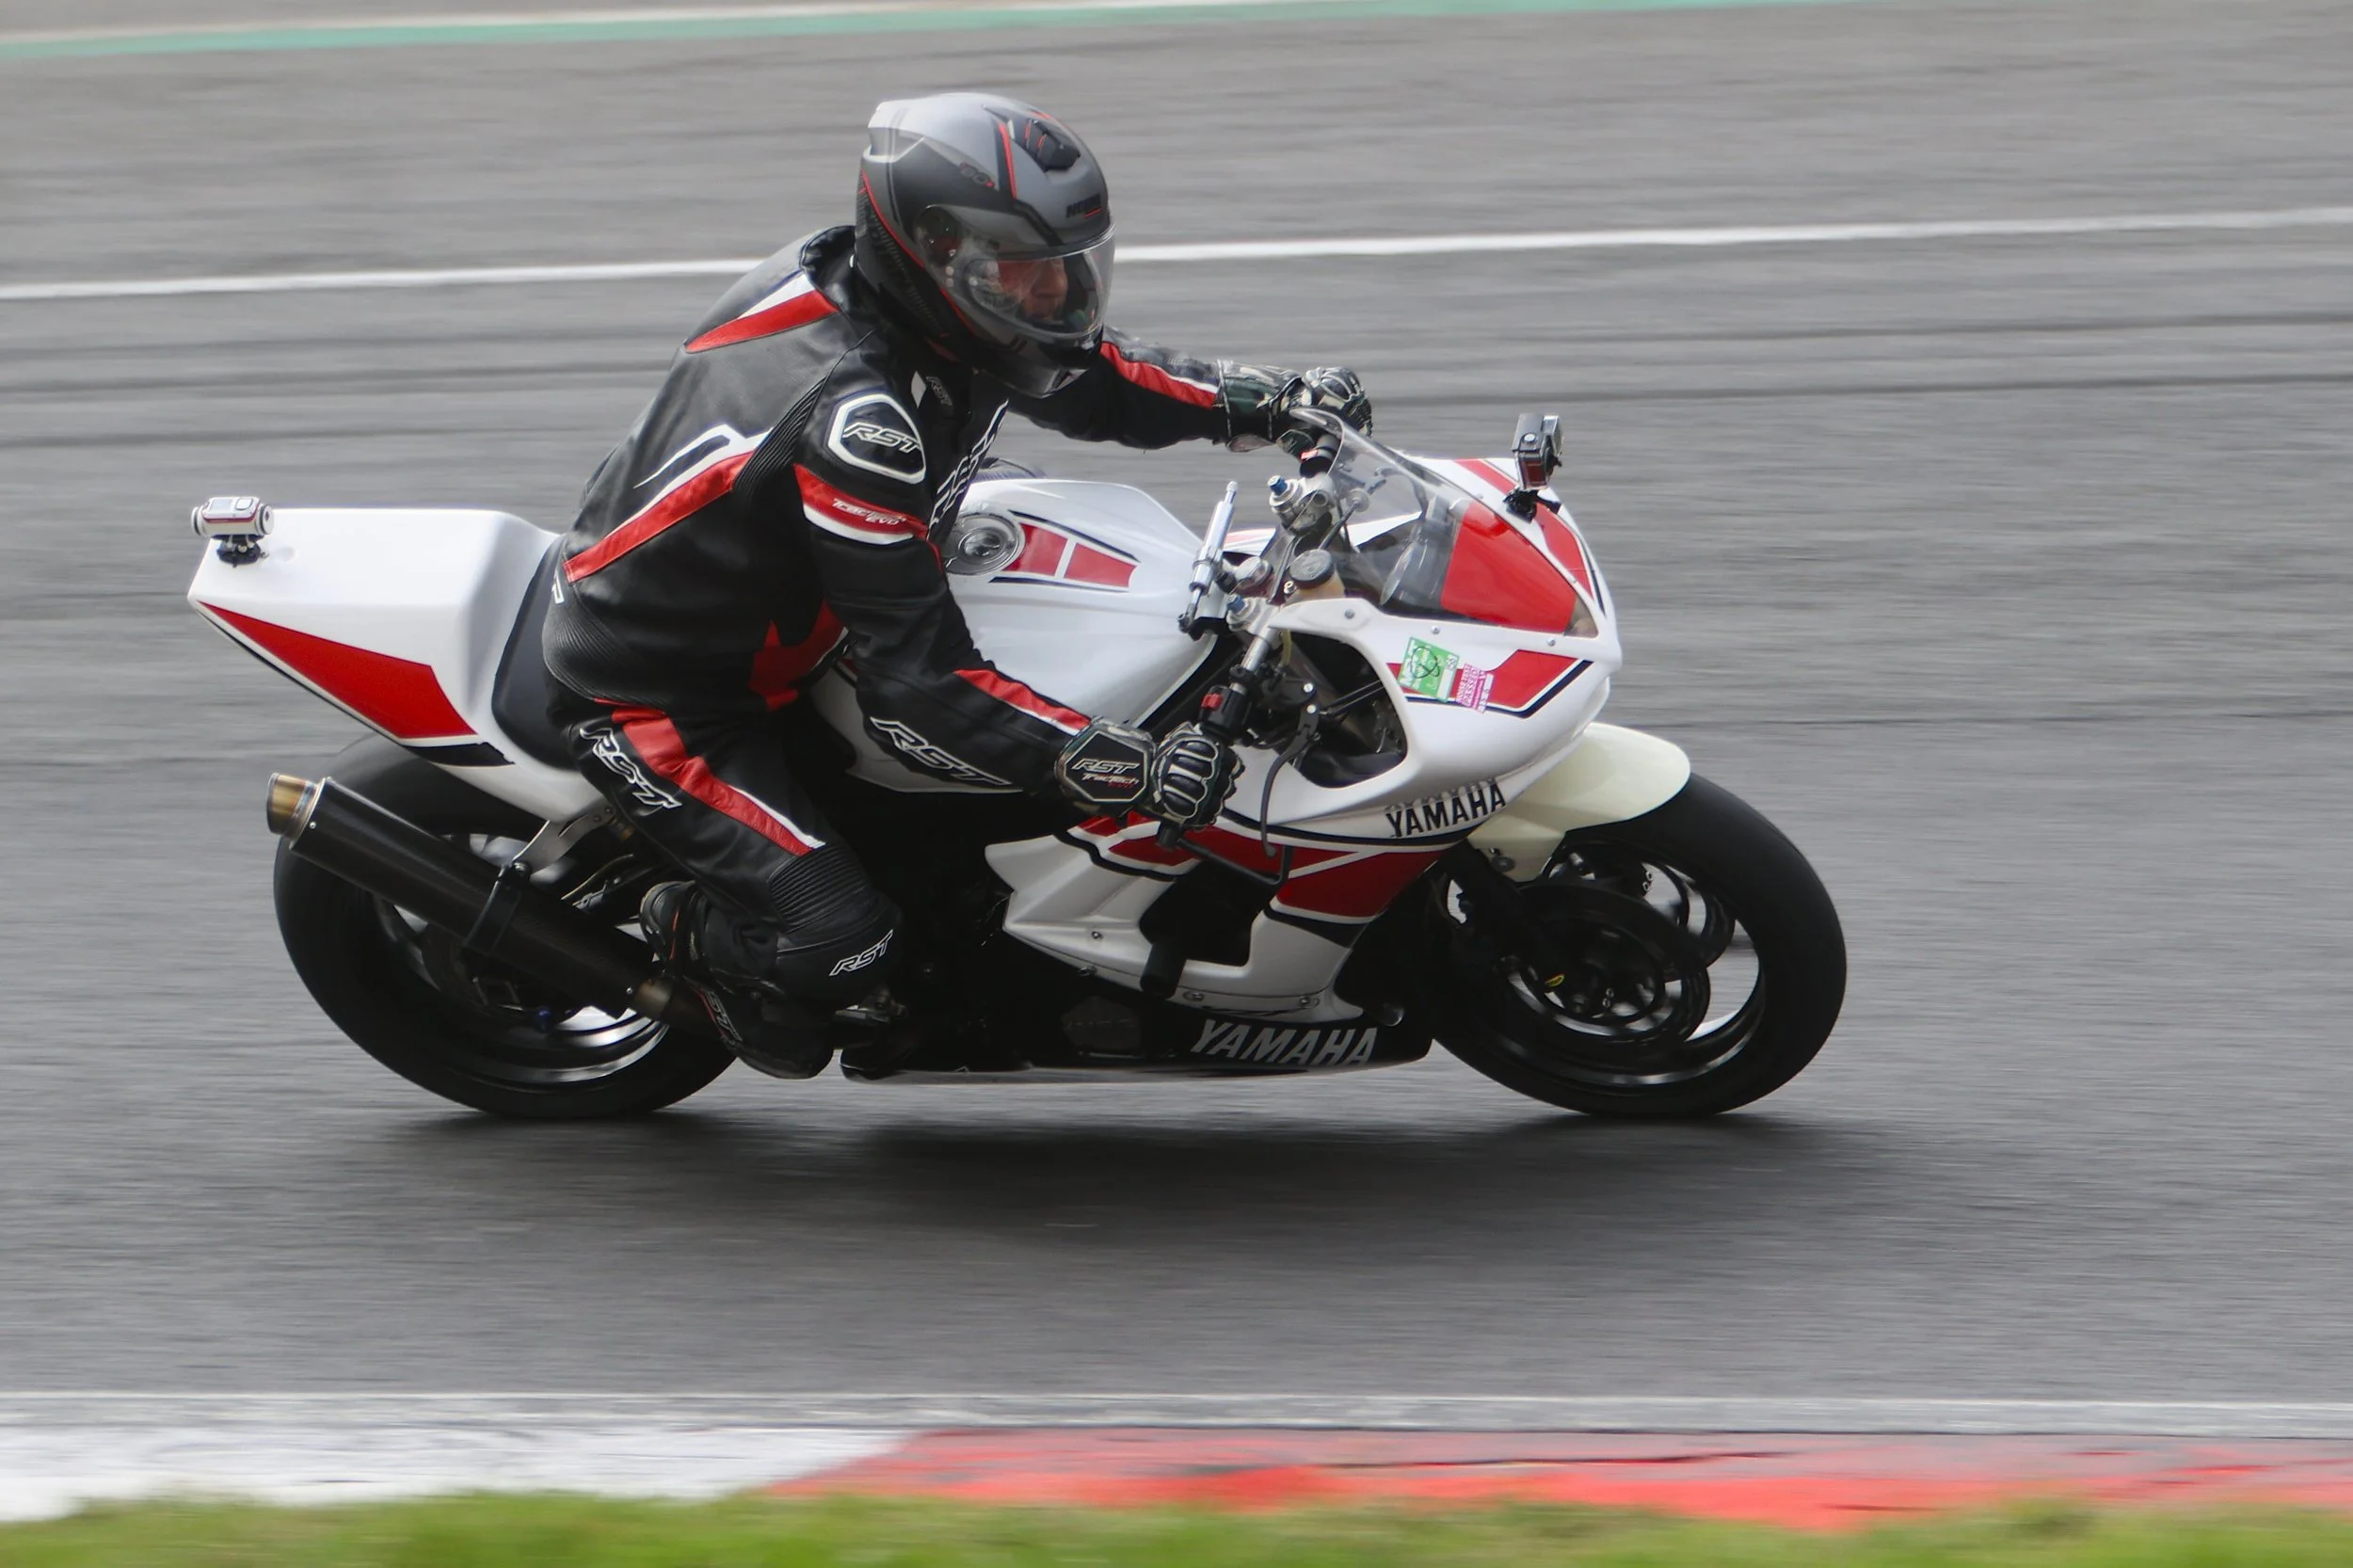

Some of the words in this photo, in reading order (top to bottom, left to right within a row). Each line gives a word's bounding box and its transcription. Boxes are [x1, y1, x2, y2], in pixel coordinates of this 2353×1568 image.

[841, 422, 921, 454] RST
[579, 727, 683, 809] RST
[869, 715, 1014, 786] RST
[1071, 758, 1141, 775] RST
[1385, 780, 1507, 838] YAMAHA
[828, 928, 894, 977] RST
[1190, 1018, 1378, 1066] YAMAHA
